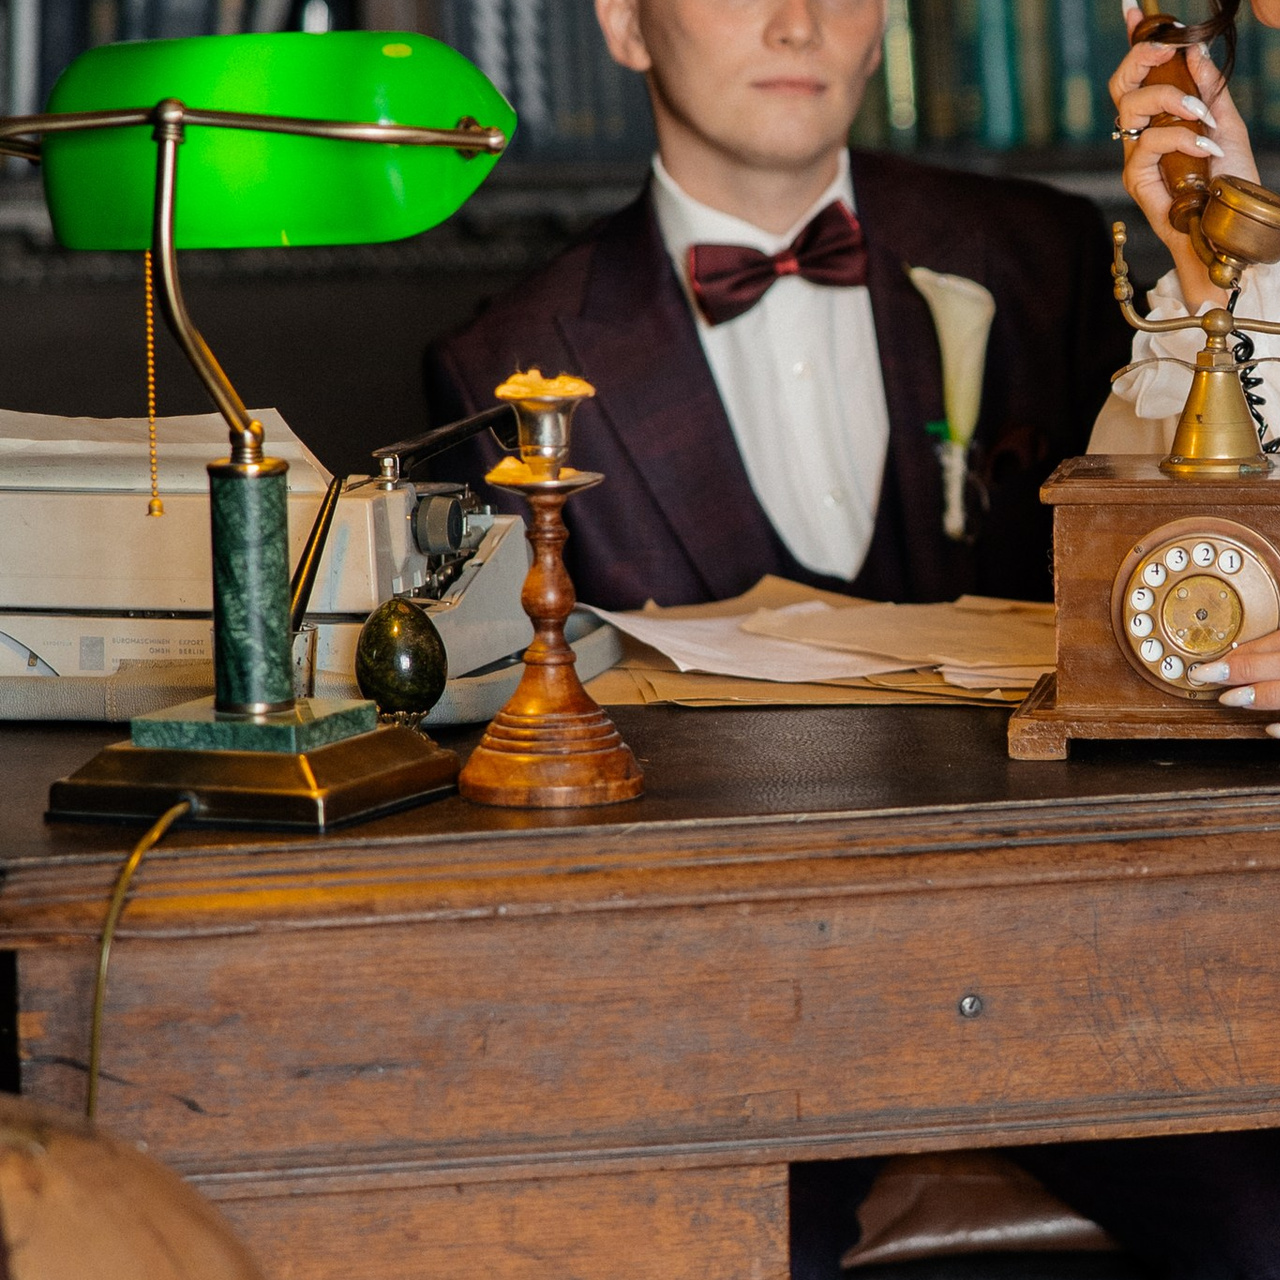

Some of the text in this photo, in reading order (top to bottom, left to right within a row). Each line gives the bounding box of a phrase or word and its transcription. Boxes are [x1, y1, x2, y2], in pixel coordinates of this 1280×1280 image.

[1175, 550, 1184, 564] 3
[1202, 548, 1210, 561] 2
[1229, 555, 1235, 568] 1
[1151, 563, 1160, 575] 4
[1137, 587, 1146, 600] 5
[1133, 615, 1142, 627] 6
[1146, 640, 1153, 653] 7
[1164, 657, 1173, 670] 8
